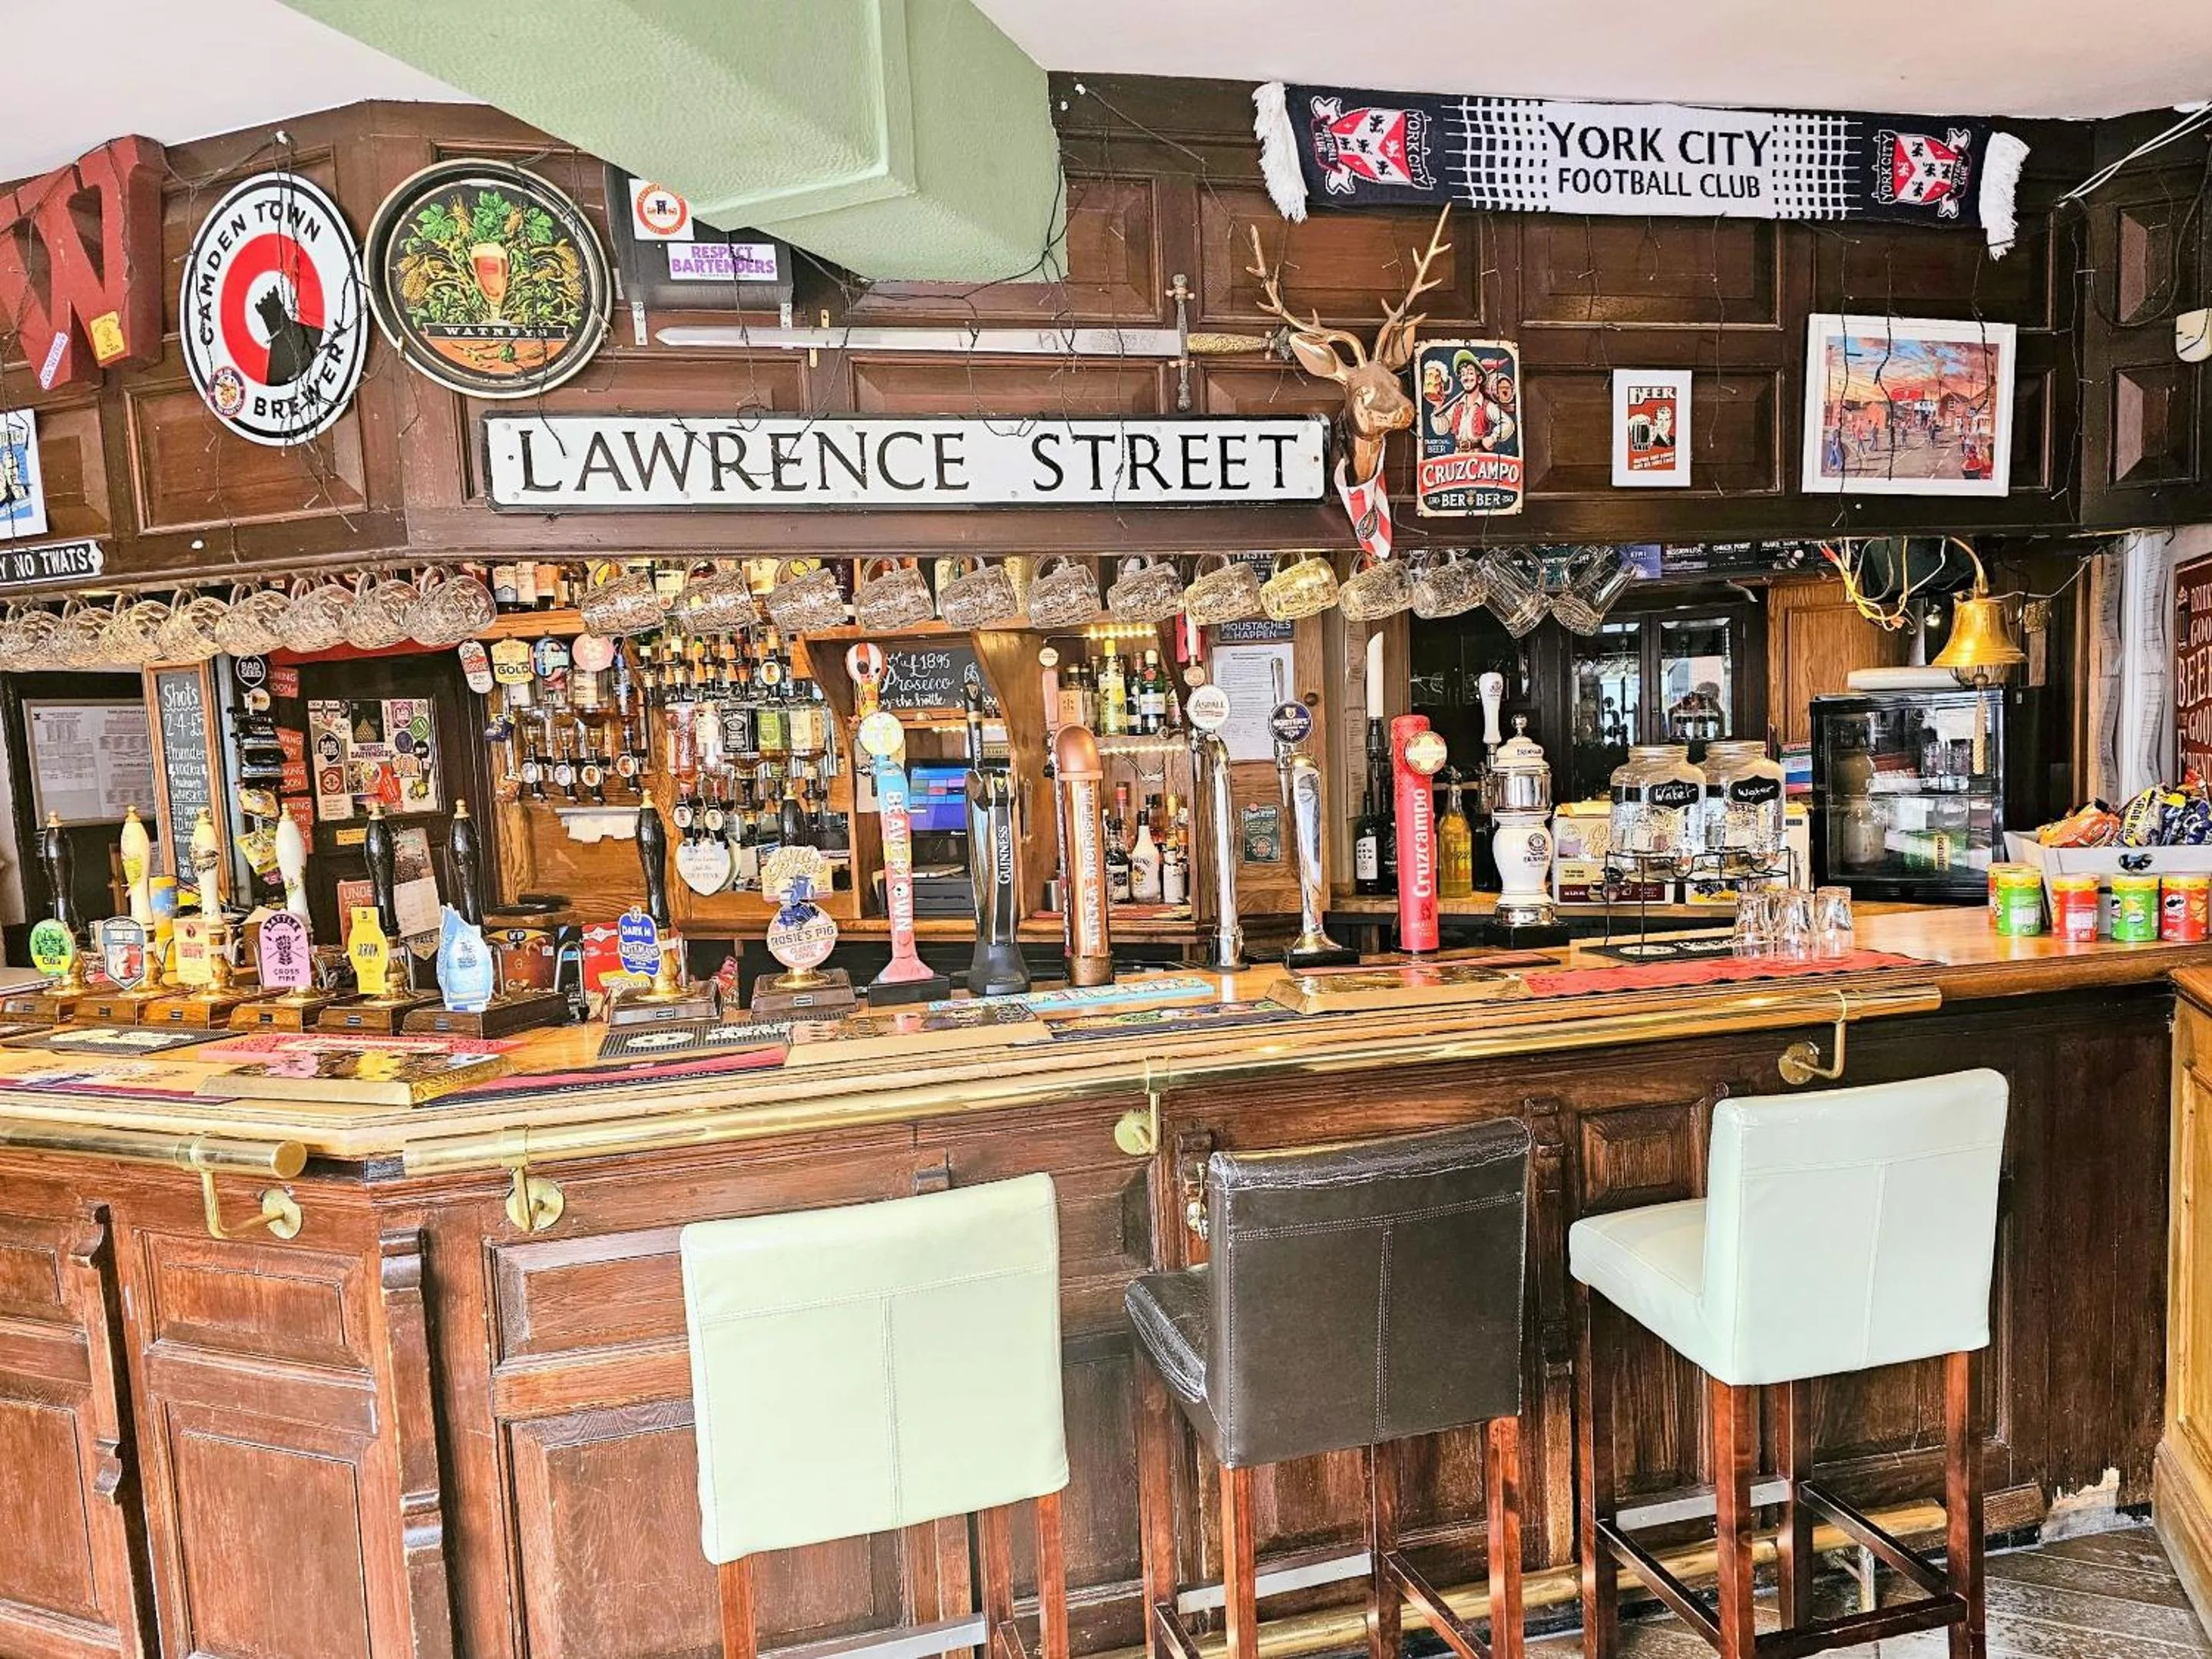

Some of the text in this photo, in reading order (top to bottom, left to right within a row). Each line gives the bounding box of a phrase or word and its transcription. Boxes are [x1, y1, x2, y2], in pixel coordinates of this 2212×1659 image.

[1407, 113, 1428, 186] YORK CITY
[1547, 122, 1771, 167] YORK CITY
[1881, 134, 1894, 201] YORK CITY
[1559, 168, 1761, 198] FOOTBALL CLUB
[691, 245, 753, 259] RESPECT
[200, 200, 321, 346] CAMDEN TOWN
[671, 258, 775, 275] BARTENDERS
[253, 318, 347, 419] BREWERY
[1628, 387, 1676, 405] BEER
[518, 429, 1299, 492] LAWRENCE STREET
[1427, 445, 1447, 454] BEER
[1422, 458, 1520, 488] CRUZCAMPO
[1441, 494, 1466, 507] BER
[1476, 494, 1501, 507] BER
[0, 547, 88, 580] Y NO TWATS
[1222, 620, 1291, 633] MOUSTACHES
[1234, 629, 1278, 639] HAPPEN
[2191, 616, 2212, 647] GOO
[240, 661, 260, 670] BAD
[240, 668, 263, 678] SEED
[497, 665, 530, 676] GOLD
[164, 681, 199, 708] Shots
[2188, 705, 2212, 748] GOO
[1655, 788, 1697, 801] Water
[1738, 785, 1775, 797] Water
[998, 825, 1010, 884] GUINNESS
[1412, 788, 1431, 898] Cruzcampo
[885, 791, 911, 932] BEAVERTOWN
[343, 885, 373, 900] UNDE
[622, 924, 643, 937] DARK
[770, 925, 835, 946] ROSIE'S PIG
